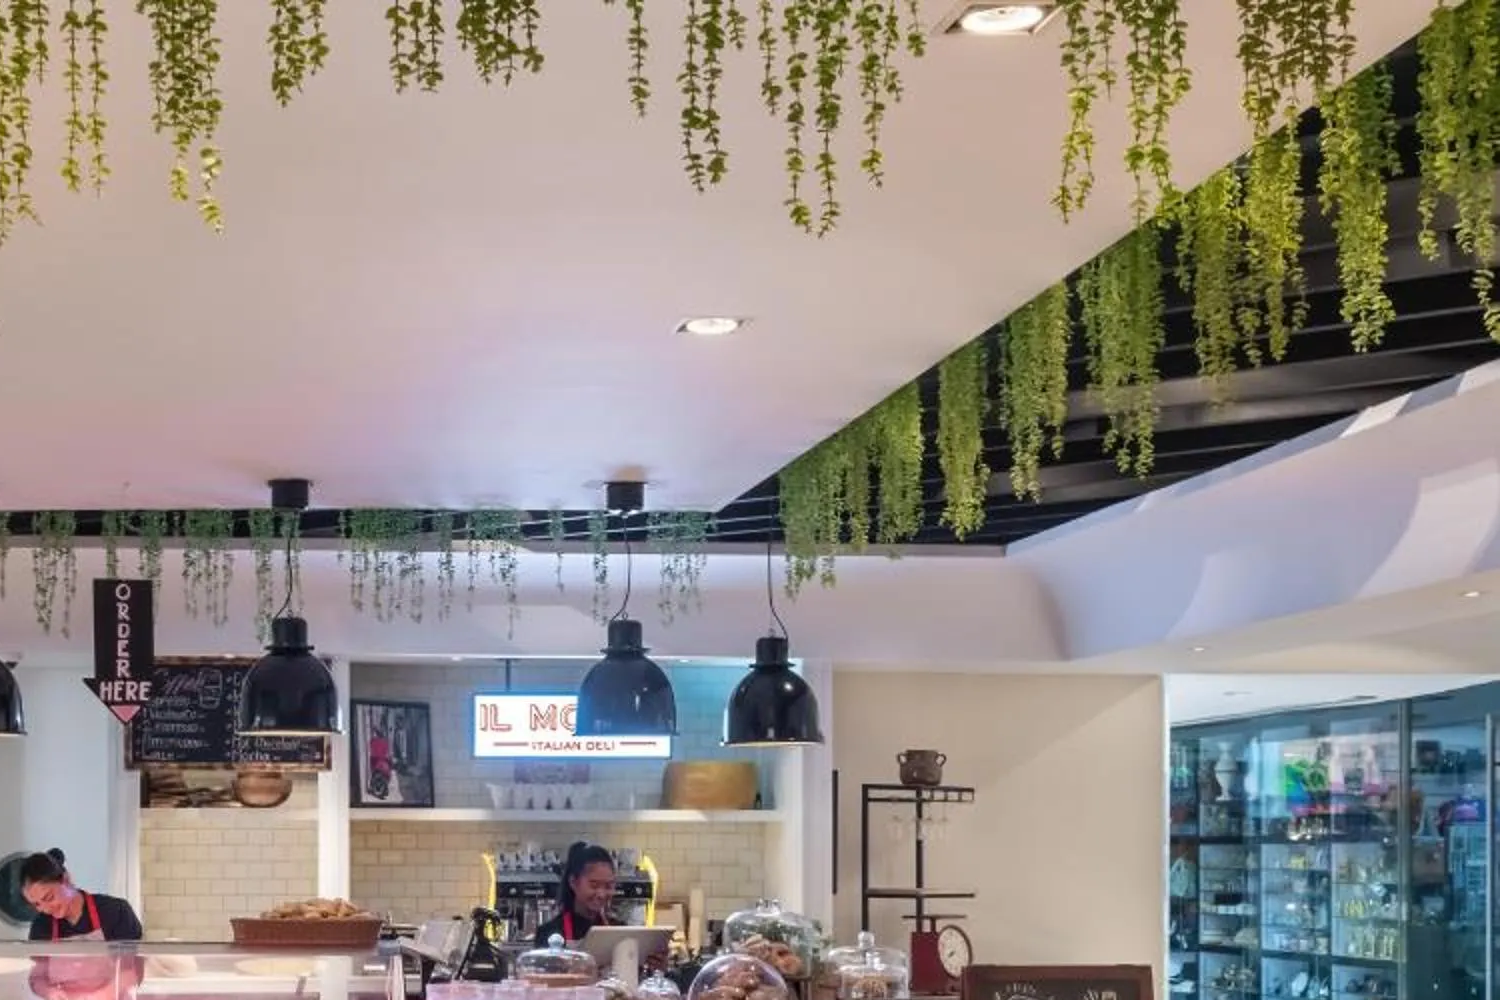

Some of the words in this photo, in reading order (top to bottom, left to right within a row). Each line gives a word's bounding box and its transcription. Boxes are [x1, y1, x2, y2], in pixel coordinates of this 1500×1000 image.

[115, 583, 132, 678] ORDER
[99, 679, 153, 702] HERE
[479, 703, 512, 732] IL
[532, 741, 581, 751] ITALIAN
[586, 741, 615, 751] DELI
